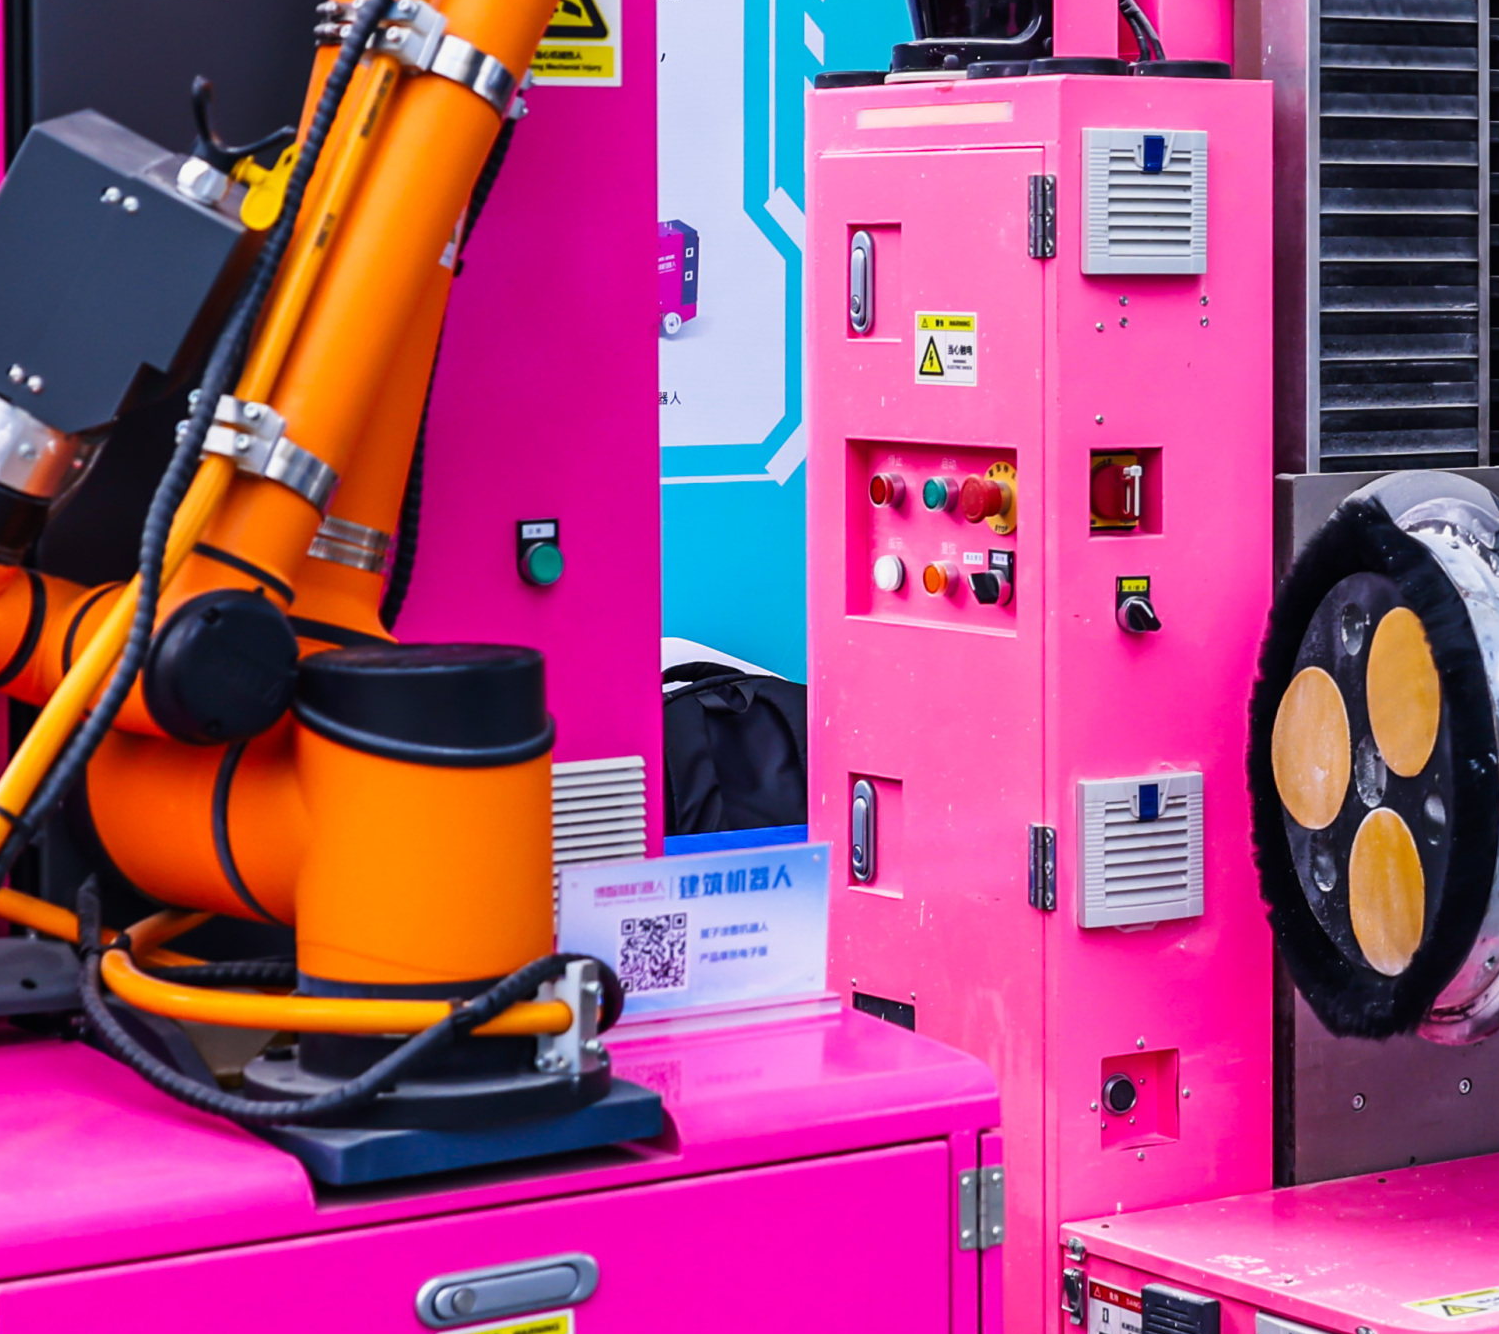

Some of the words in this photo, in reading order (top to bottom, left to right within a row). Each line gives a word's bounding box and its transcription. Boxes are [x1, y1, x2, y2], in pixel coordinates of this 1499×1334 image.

[678, 864, 793, 900] 建筑机器人
